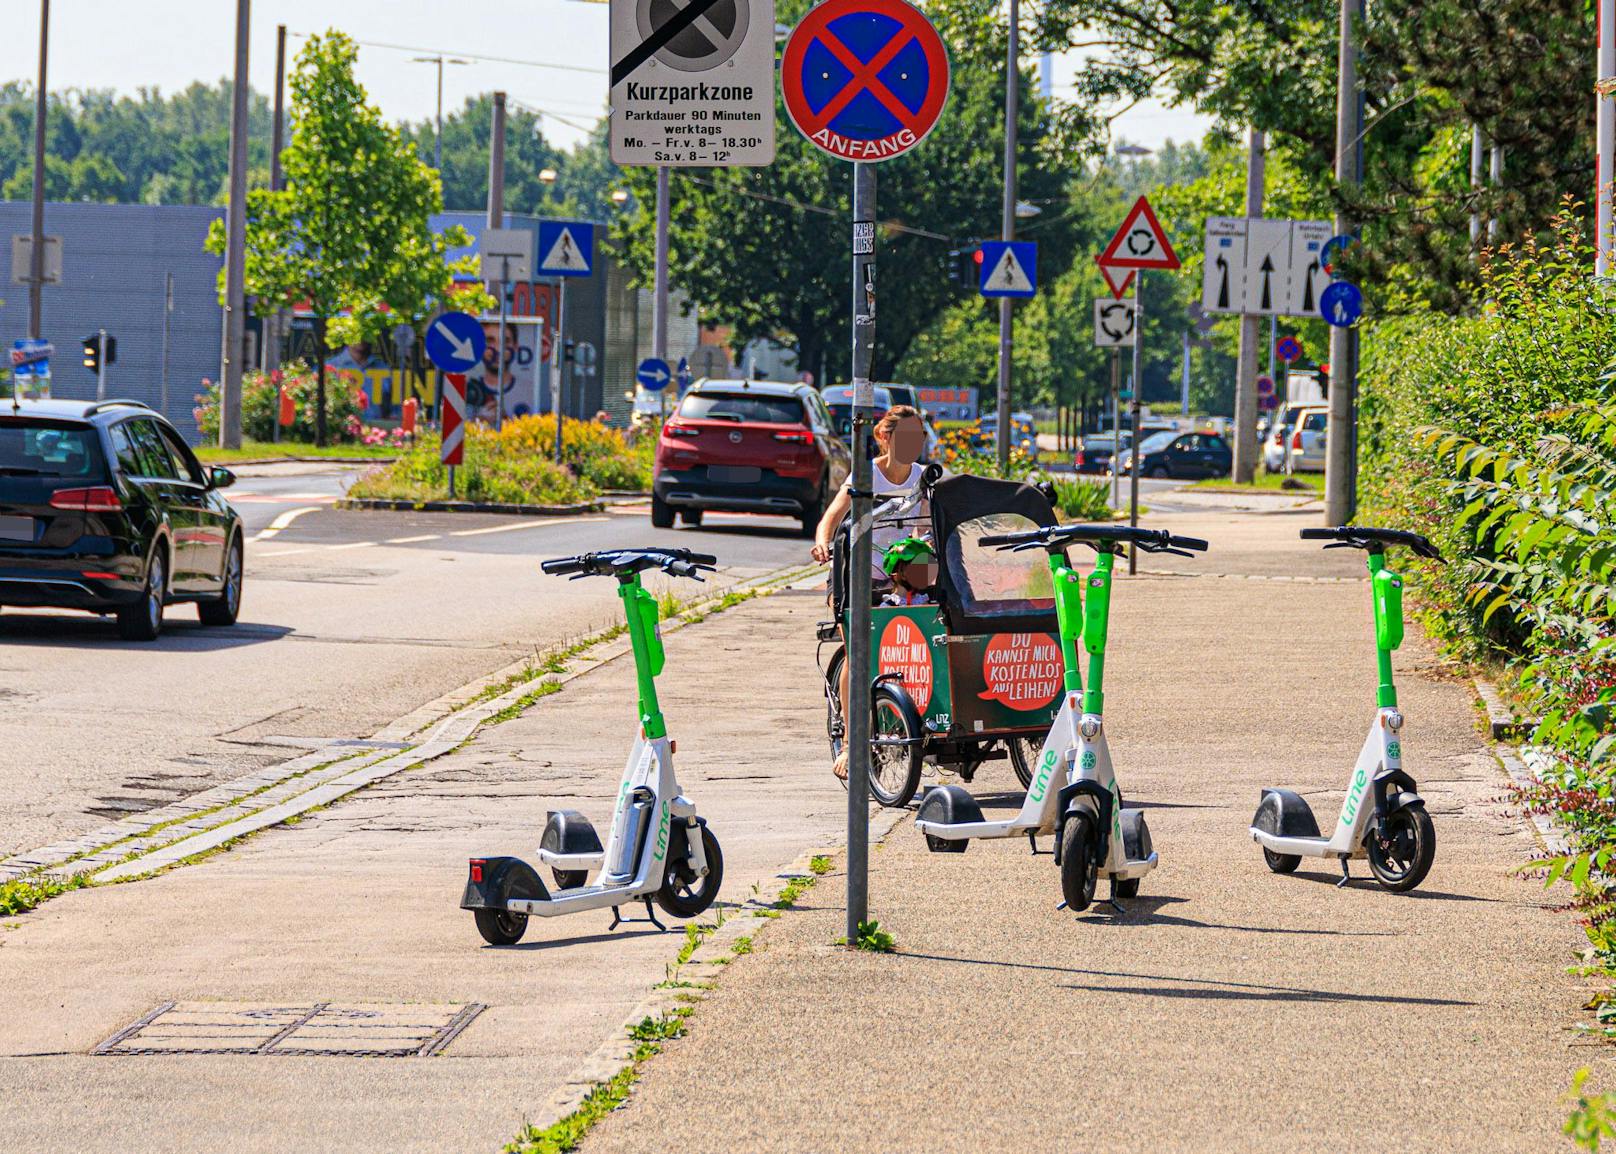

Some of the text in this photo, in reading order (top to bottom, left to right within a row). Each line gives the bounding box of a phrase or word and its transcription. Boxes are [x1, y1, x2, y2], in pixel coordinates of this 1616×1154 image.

[627, 82, 753, 104] Kurzparkzone
[625, 110, 761, 121] Parkdauer 90 Minuten
[664, 124, 722, 135] werktags
[624, 138, 647, 148] Mo.
[811, 128, 917, 157] ANFANG
[655, 151, 685, 161] Sa.v.
[896, 624, 910, 644] DU
[1011, 633, 1031, 648] DU
[881, 643, 927, 663] KANNST MICH
[987, 644, 1056, 664] KANNST MICH
[990, 663, 1061, 682] KOSTENLOS
[1029, 749, 1058, 804] Lime
[1342, 769, 1367, 826] Lime
[653, 800, 671, 861] Lime
